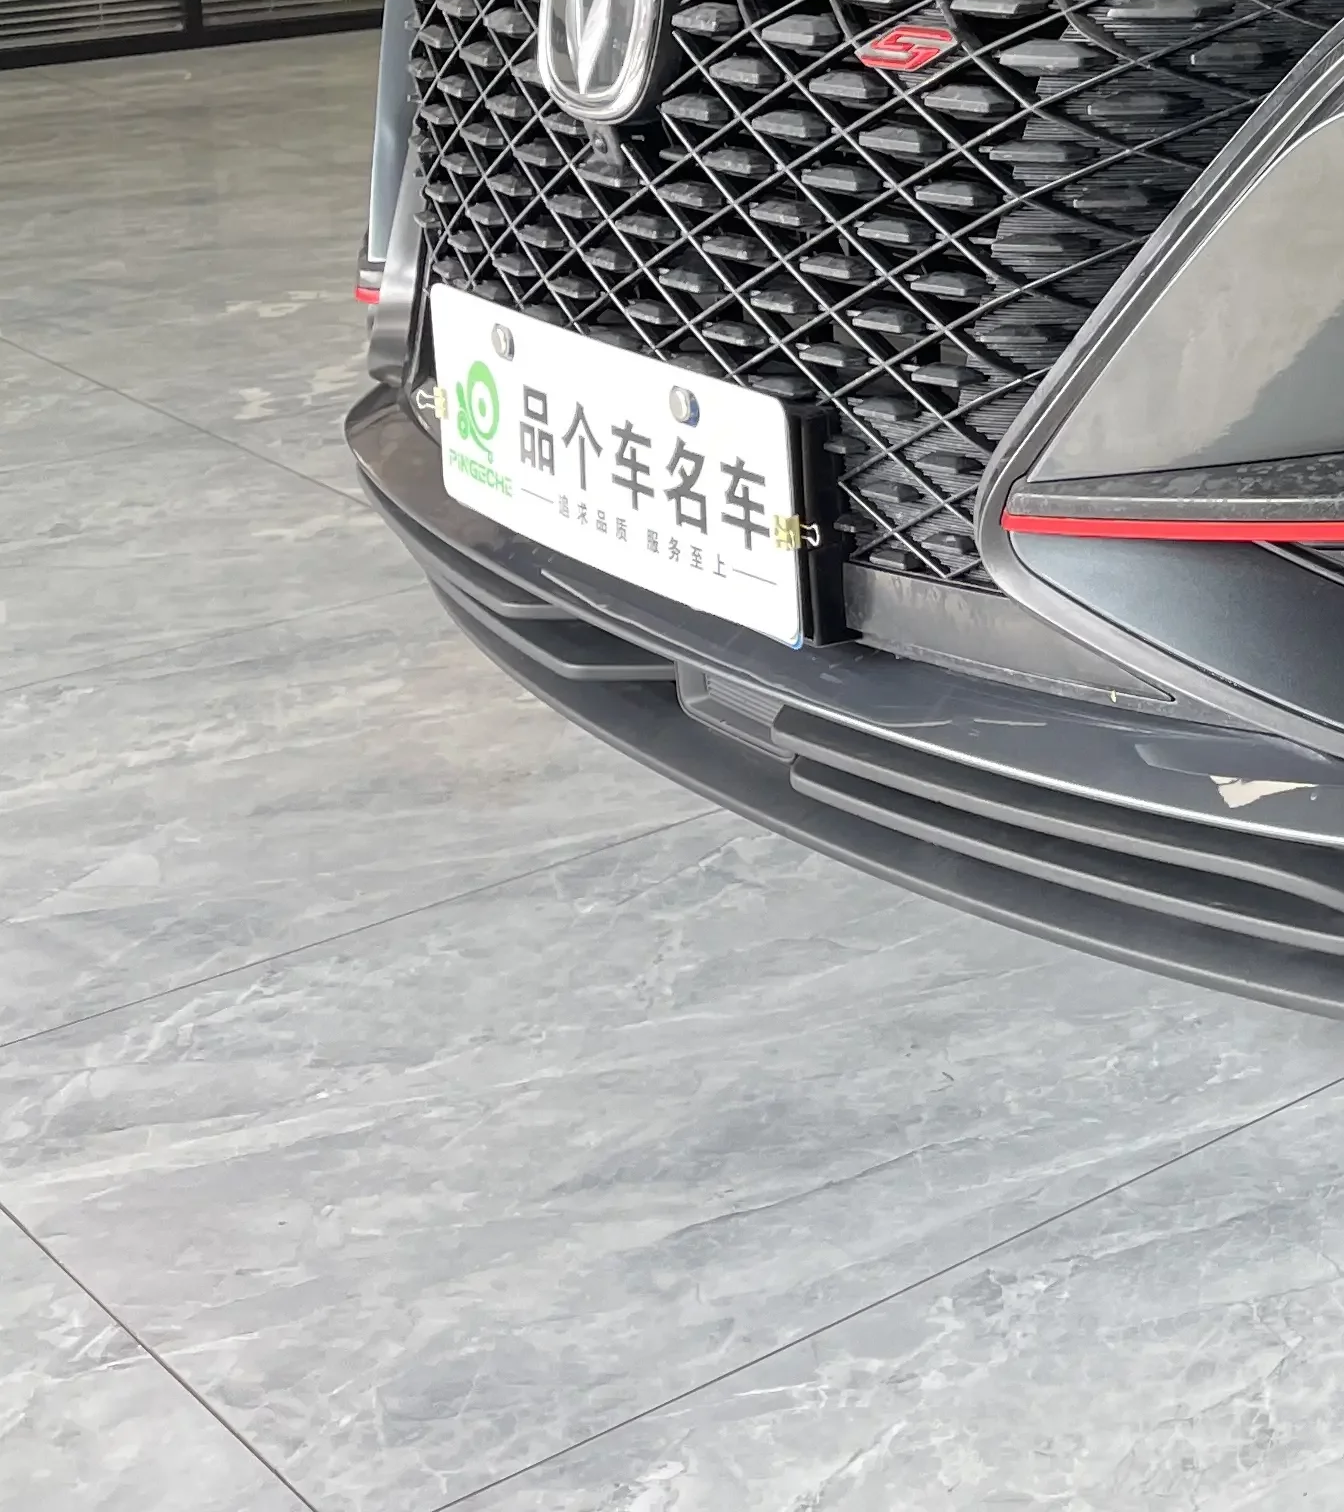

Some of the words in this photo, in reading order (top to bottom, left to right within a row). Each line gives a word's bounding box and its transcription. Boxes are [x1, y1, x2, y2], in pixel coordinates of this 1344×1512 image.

[519, 384, 771, 551] 品个车名车
[557, 494, 628, 542] 追求品质
[646, 528, 727, 579] 服务至上
